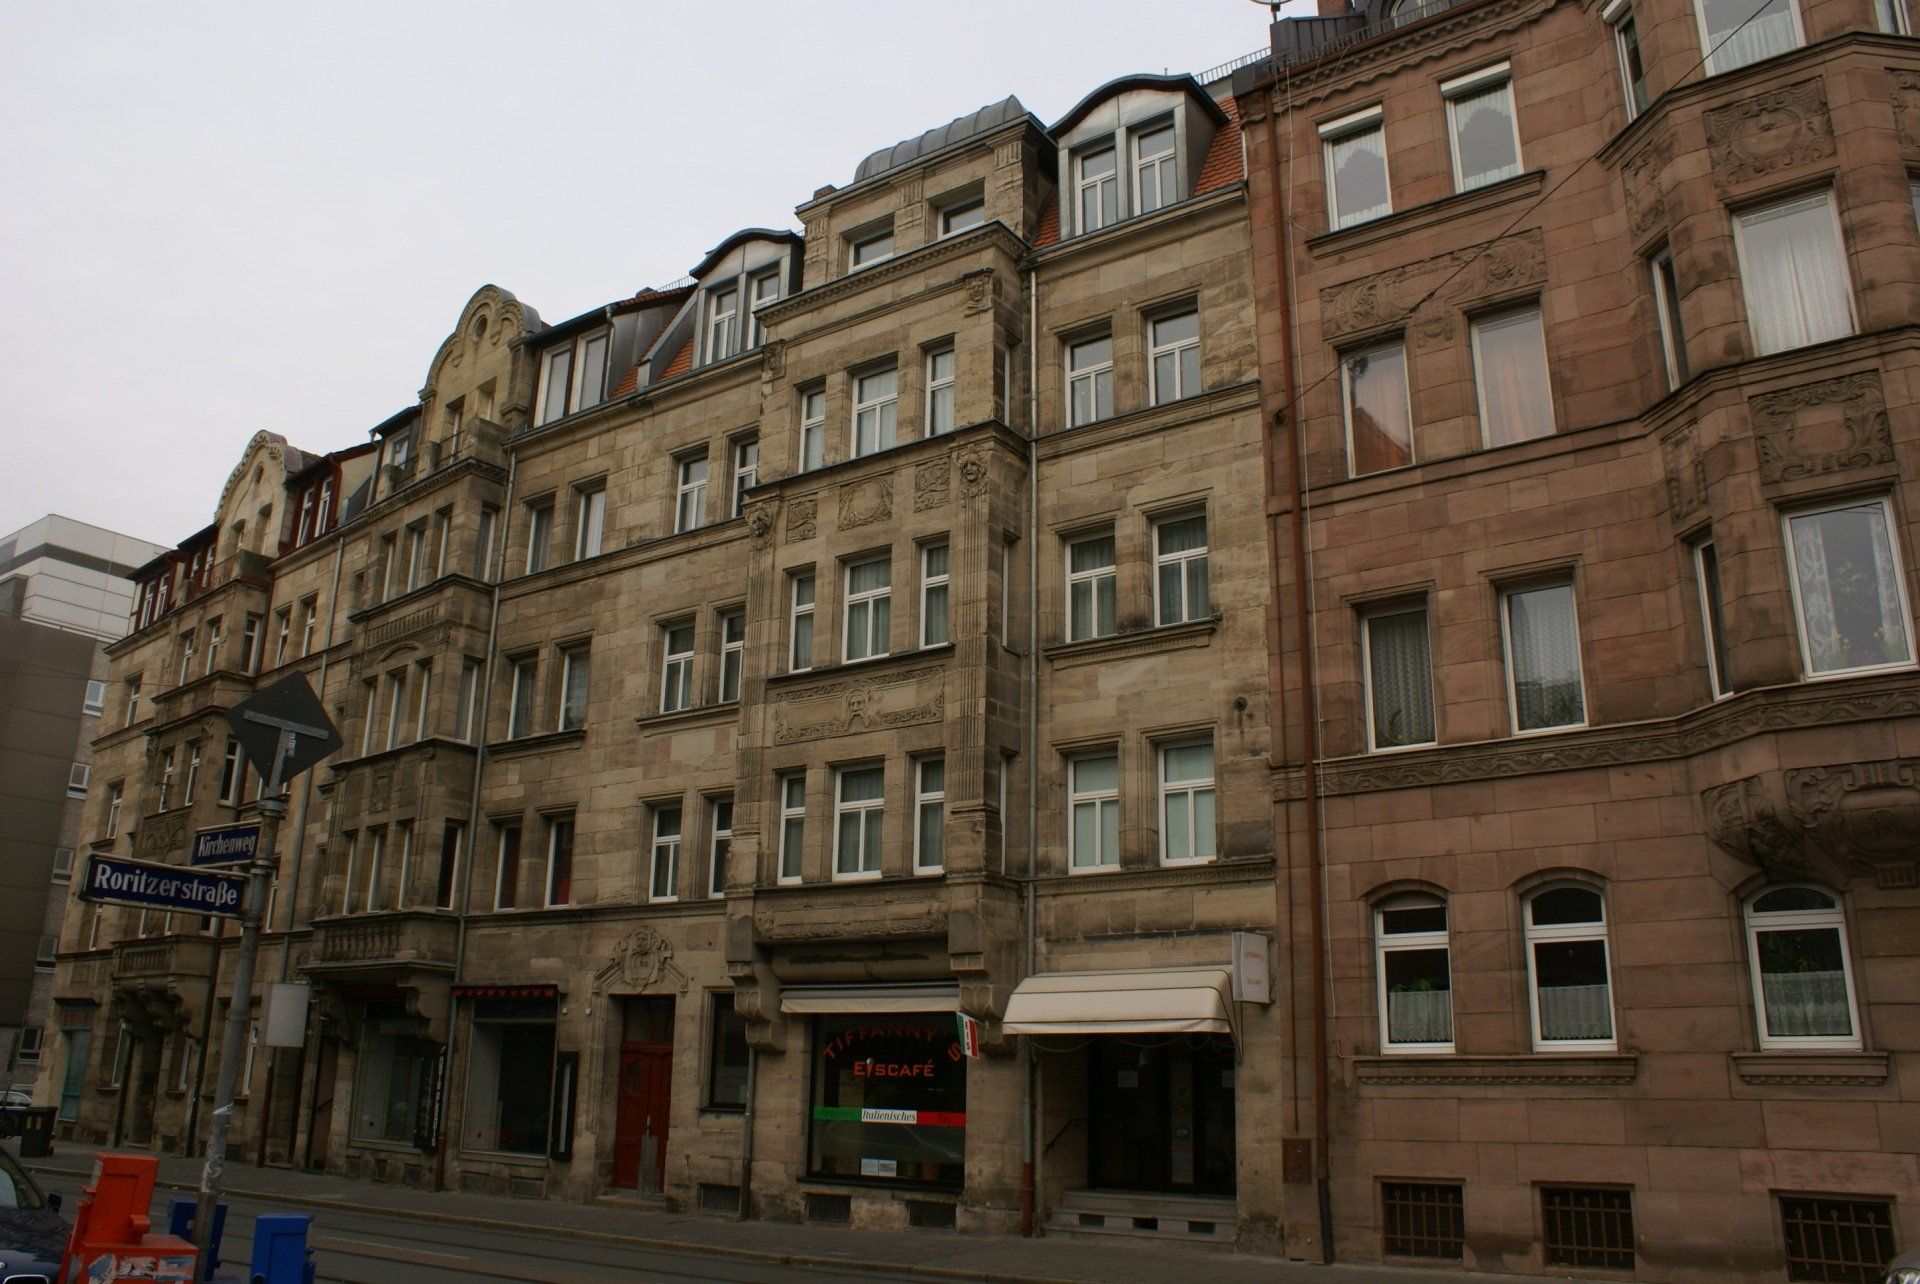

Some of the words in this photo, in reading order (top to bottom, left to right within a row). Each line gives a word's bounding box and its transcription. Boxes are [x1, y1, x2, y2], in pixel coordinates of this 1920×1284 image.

[198, 834, 256, 858] Kirchenweg
[94, 864, 238, 907] Roritzerstraße
[863, 1109, 916, 1123] Italienisches
